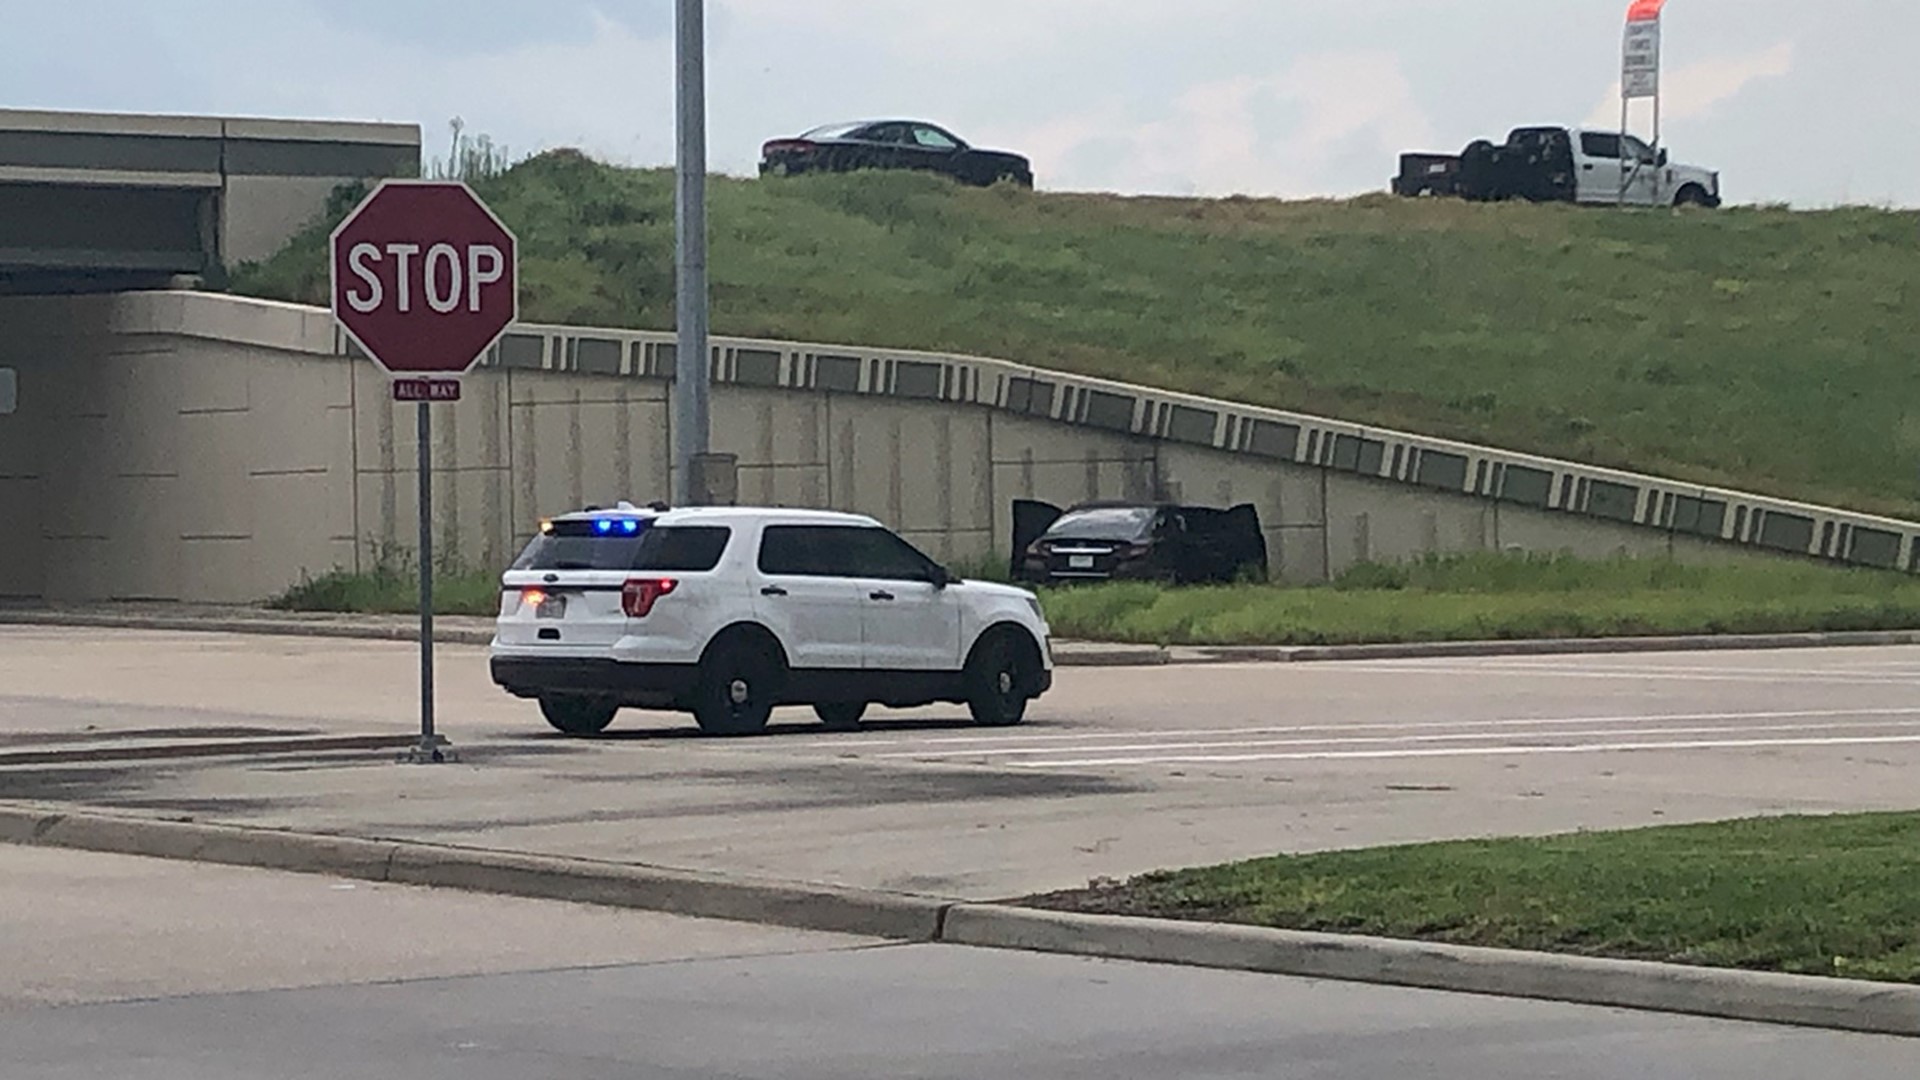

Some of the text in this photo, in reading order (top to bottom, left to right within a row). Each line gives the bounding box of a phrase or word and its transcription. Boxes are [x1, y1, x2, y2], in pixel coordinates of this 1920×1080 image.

[346, 243, 504, 313] STOP
[398, 383, 457, 398] ALL WAY
